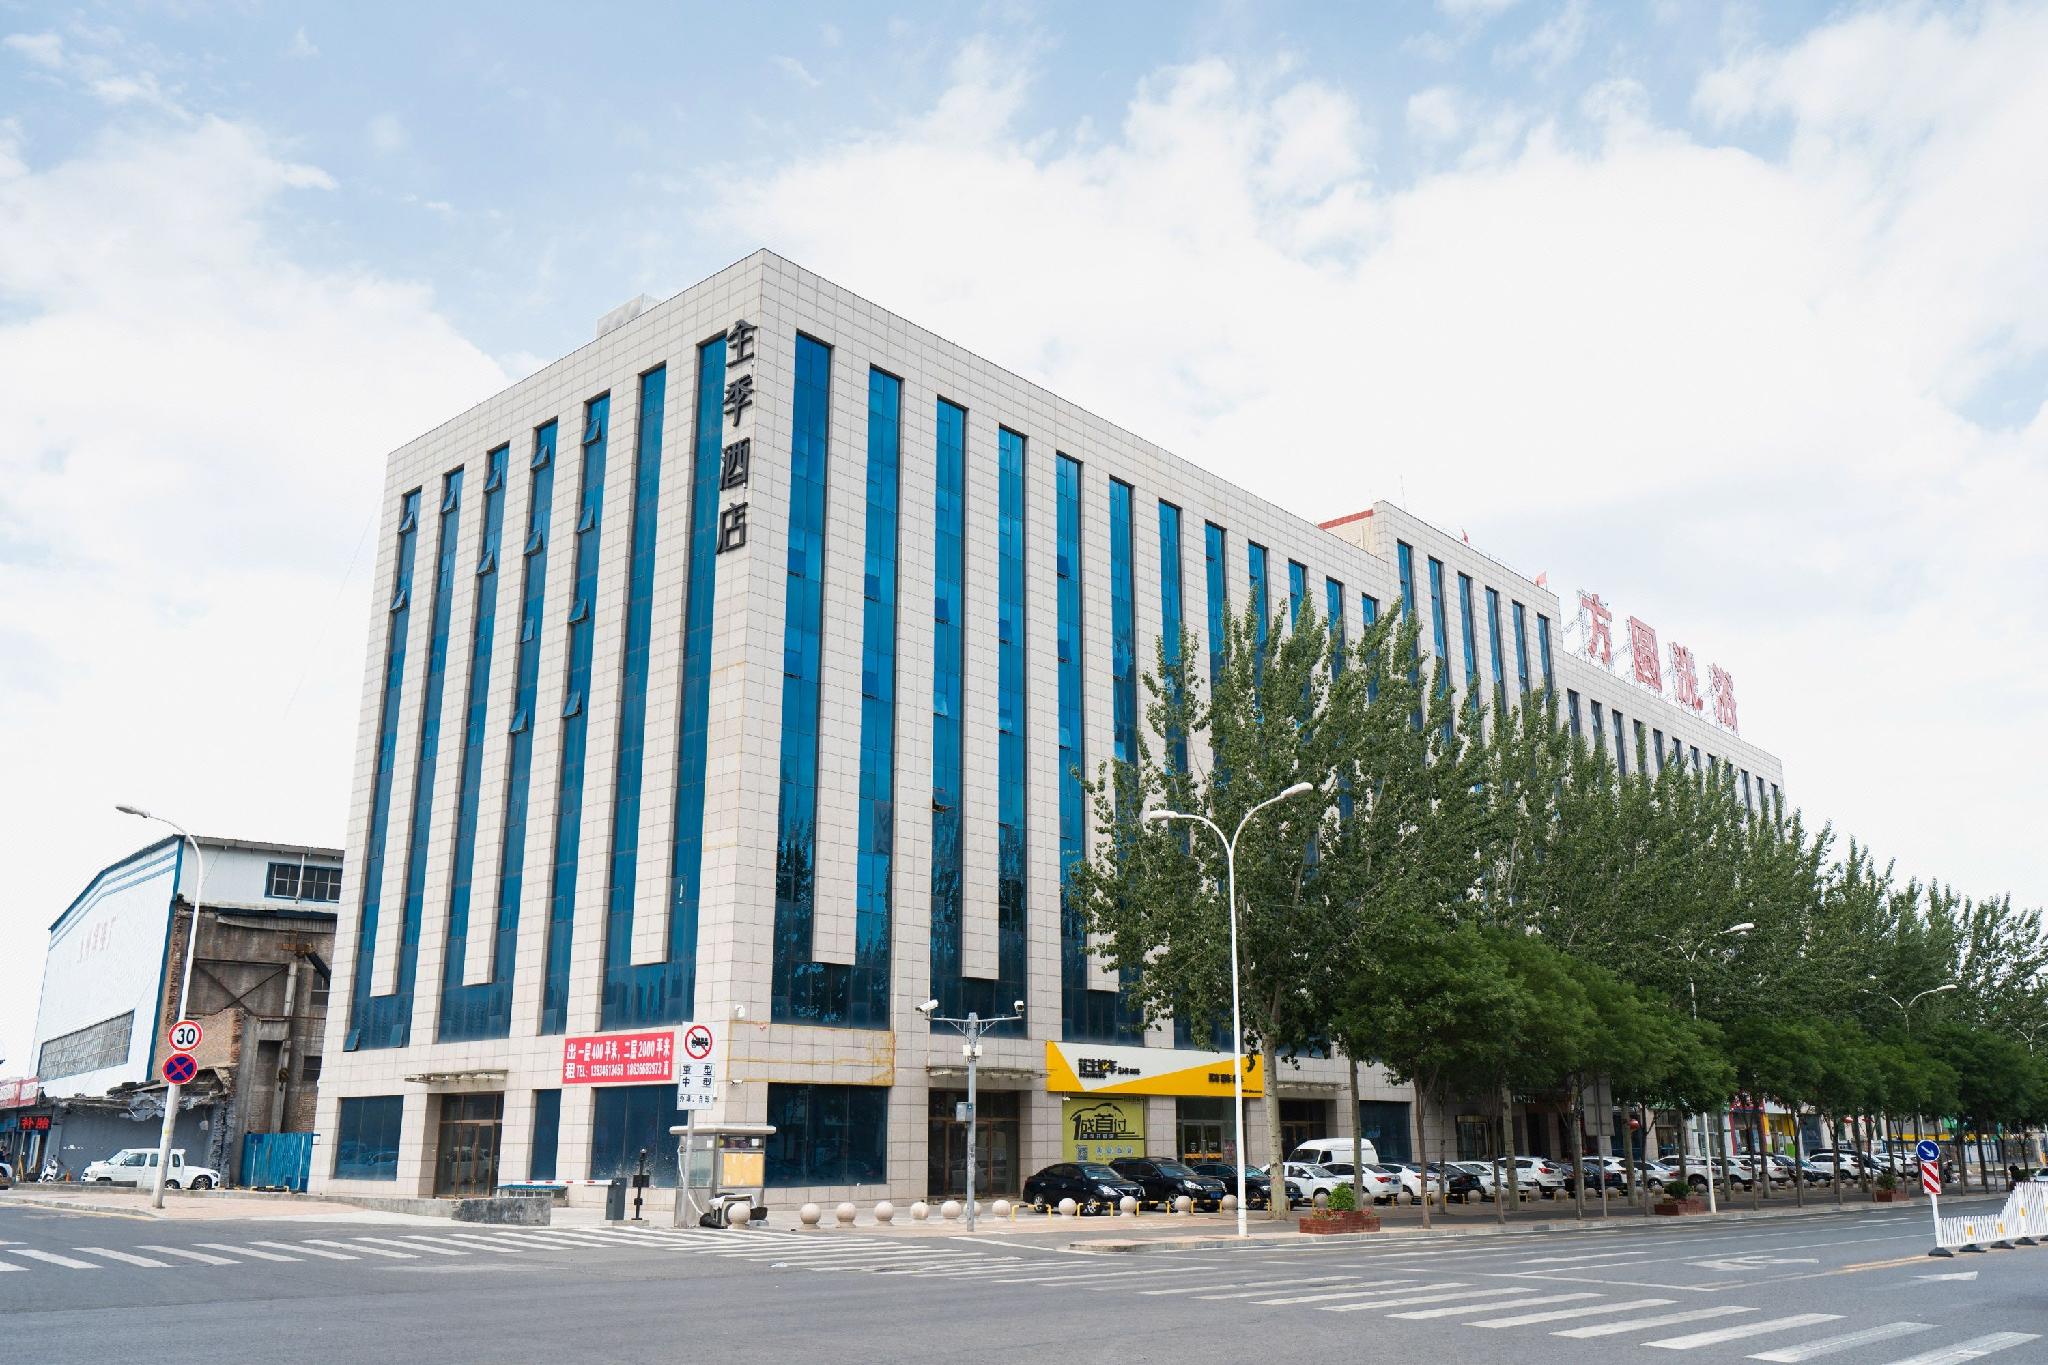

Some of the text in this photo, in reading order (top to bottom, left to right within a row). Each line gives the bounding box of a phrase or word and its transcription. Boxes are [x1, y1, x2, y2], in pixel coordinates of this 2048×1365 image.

[715, 318, 758, 555] 全季酒店
[176, 1028, 196, 1045] 30
[21, 1117, 49, 1130] 补胎
